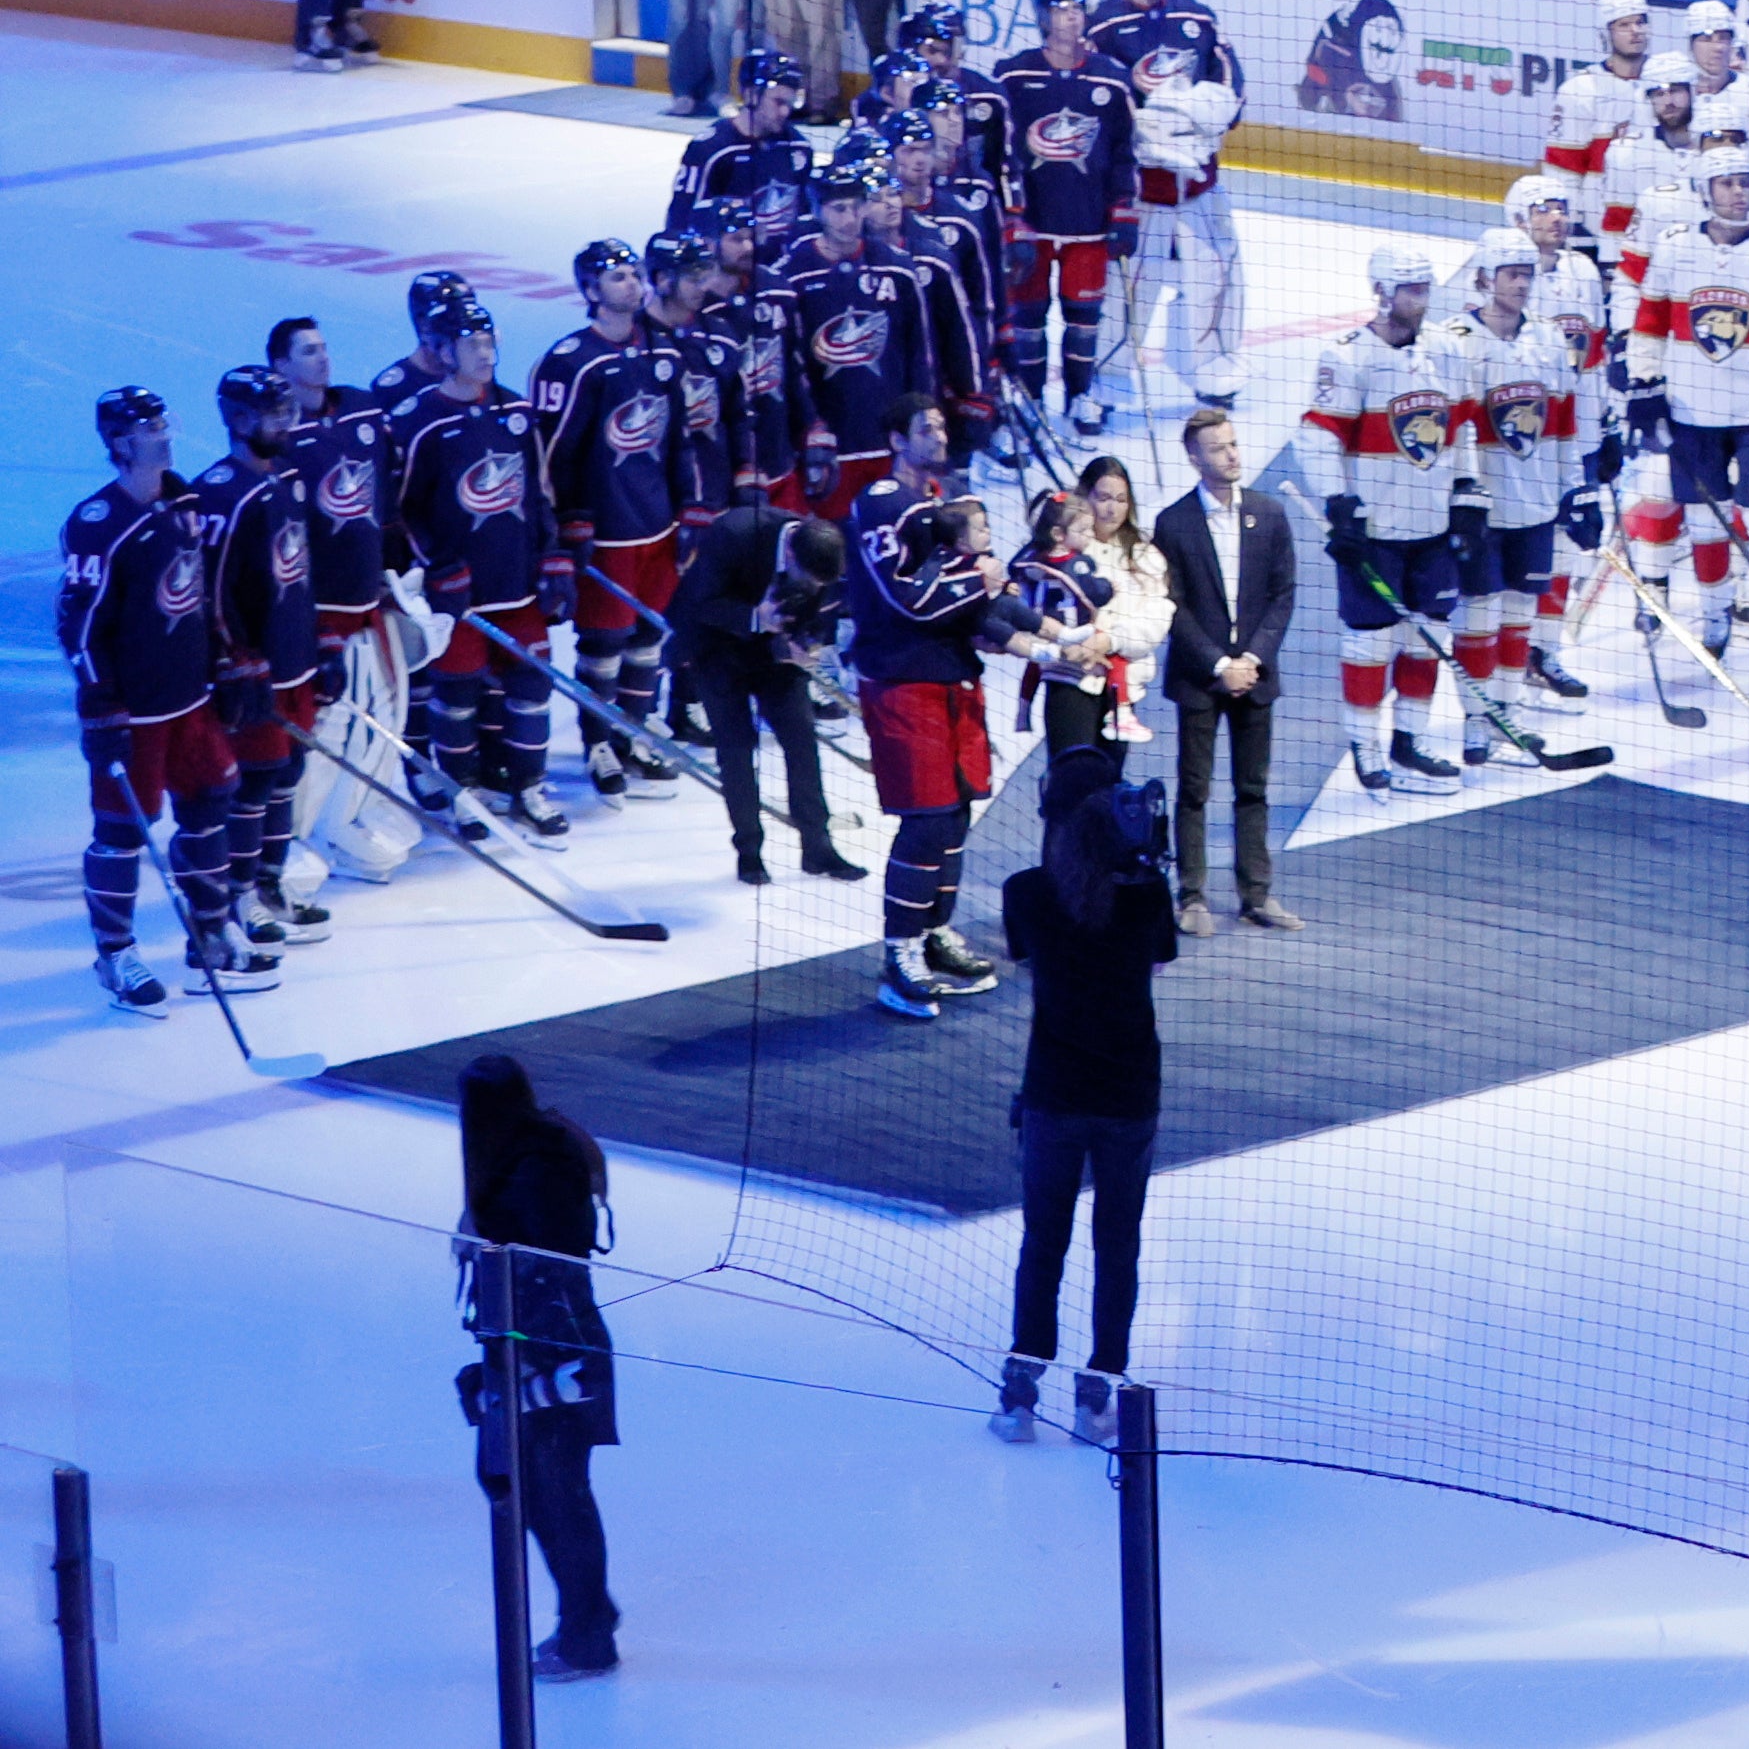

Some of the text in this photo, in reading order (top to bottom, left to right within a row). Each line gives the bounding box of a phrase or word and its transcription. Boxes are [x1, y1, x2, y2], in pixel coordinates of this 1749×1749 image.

[537, 380, 565, 412] 19
[862, 524, 899, 563] 23
[65, 553, 101, 587] 44
